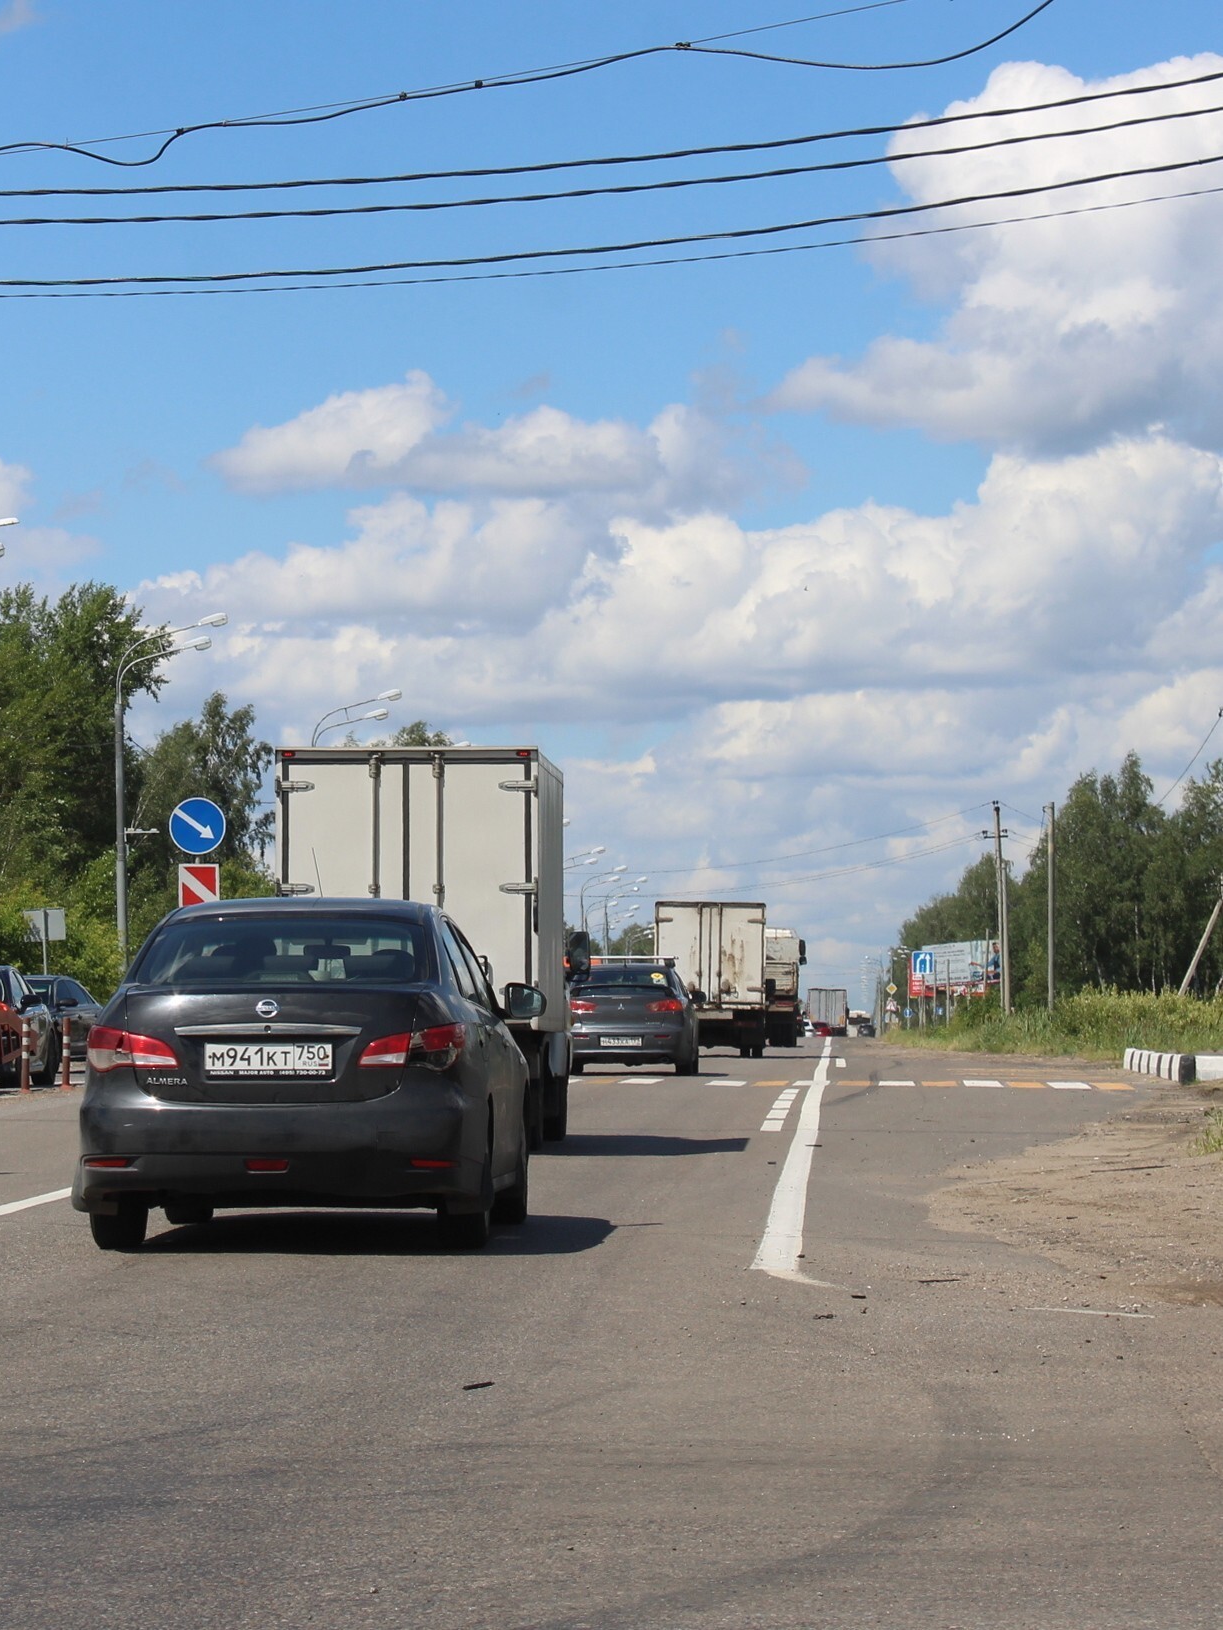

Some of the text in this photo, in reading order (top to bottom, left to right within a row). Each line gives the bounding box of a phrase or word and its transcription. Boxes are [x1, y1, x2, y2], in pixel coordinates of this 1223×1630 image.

[211, 1045, 328, 1066] М941КТ 750
[146, 1077, 188, 1086] ALMERA
